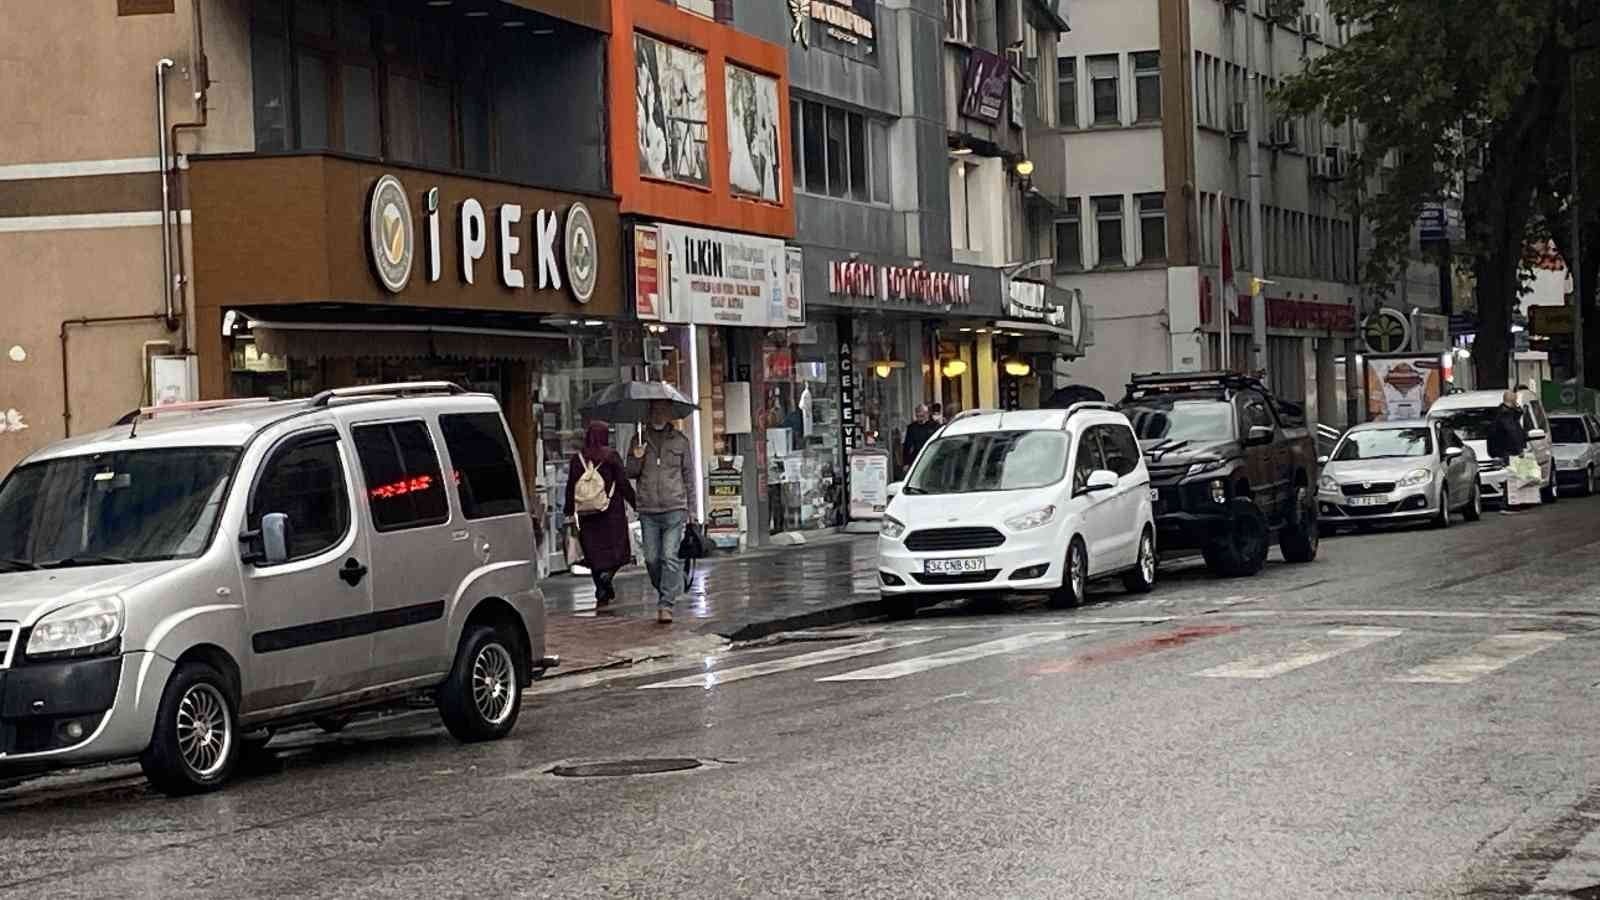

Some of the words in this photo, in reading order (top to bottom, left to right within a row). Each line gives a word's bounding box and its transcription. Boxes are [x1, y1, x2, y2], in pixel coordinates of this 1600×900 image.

[428, 186, 562, 290] İPEK
[685, 235, 724, 278] İLKİN
[840, 343, 853, 420] ACELE
